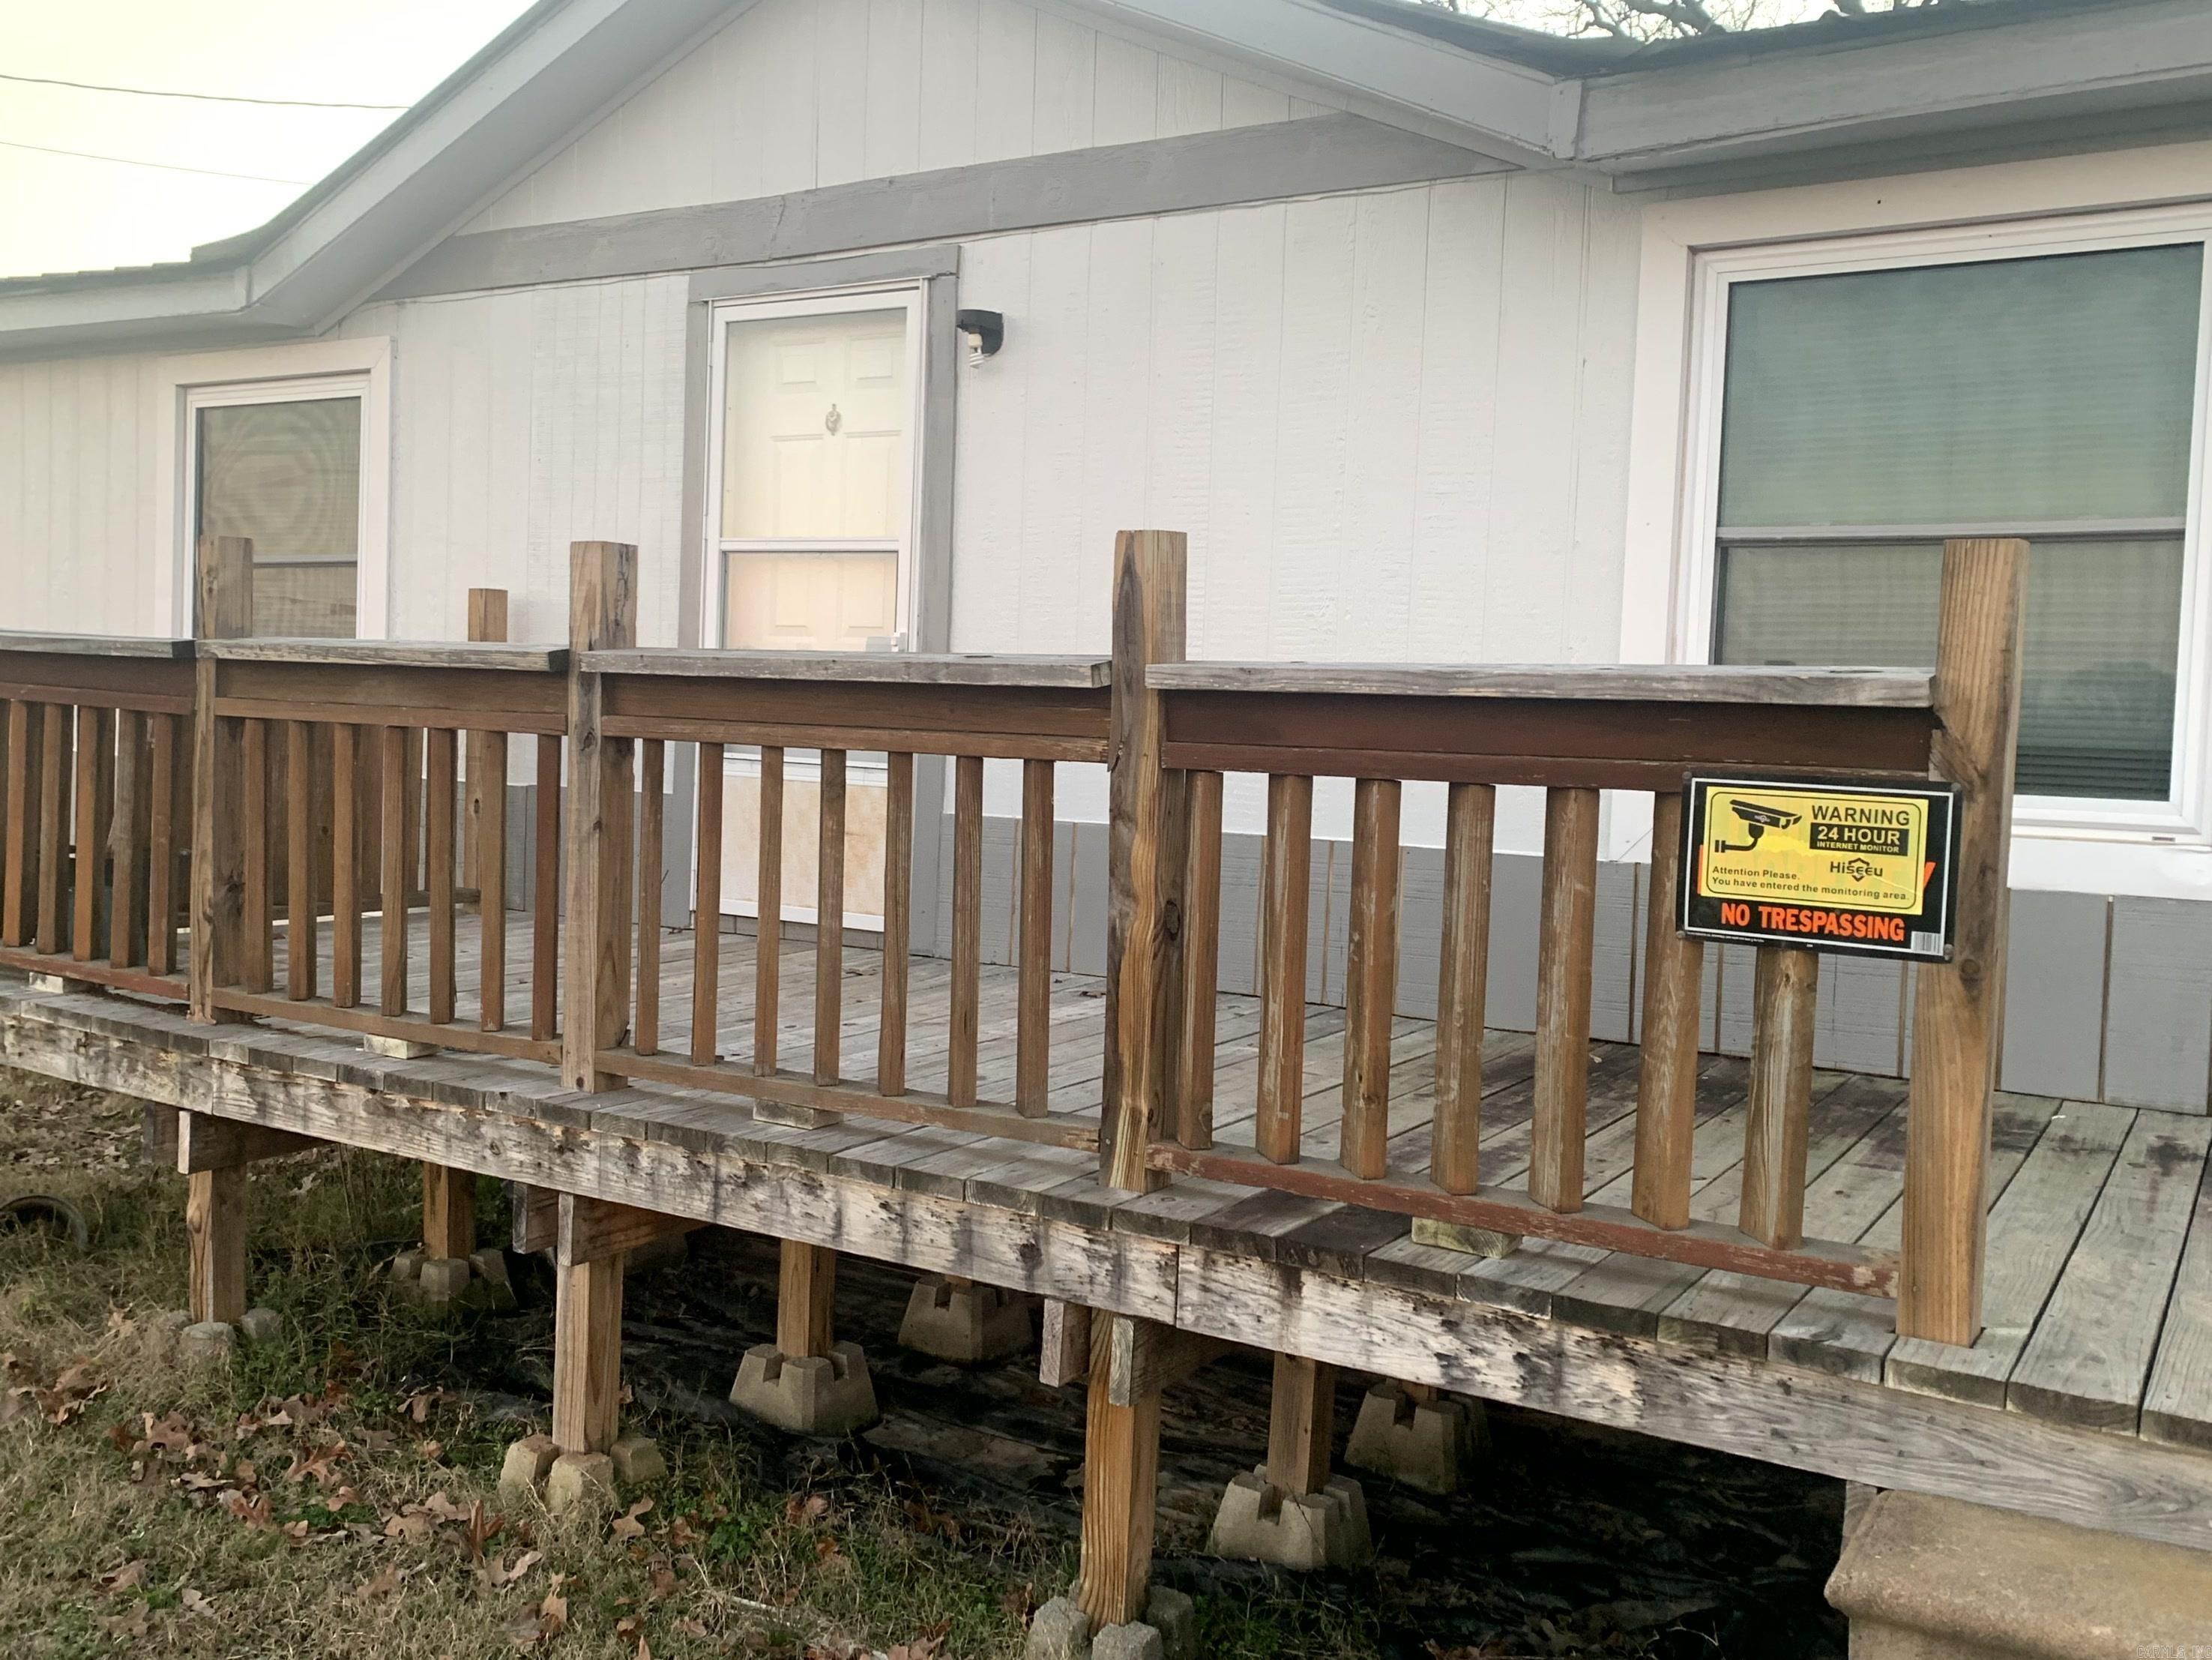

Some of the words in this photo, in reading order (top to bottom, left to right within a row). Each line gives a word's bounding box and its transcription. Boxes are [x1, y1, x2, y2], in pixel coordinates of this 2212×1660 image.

[1812, 805, 1910, 826] WARNING
[1818, 826, 1839, 840] 24
[1844, 828, 1900, 844] HOUR
[1817, 840, 1858, 850] INTERNET
[1860, 844, 1899, 852] MONITOR
[1712, 866, 1761, 877] Attention
[1763, 870, 1800, 880] Please.
[1712, 876, 1731, 885] You
[1733, 879, 1758, 888] have
[1760, 880, 1800, 891] entered
[1802, 883, 1818, 893] the
[1821, 885, 1880, 899] monitoring
[1721, 903, 1750, 926] NO
[1759, 906, 1905, 942] TRESPASSING
